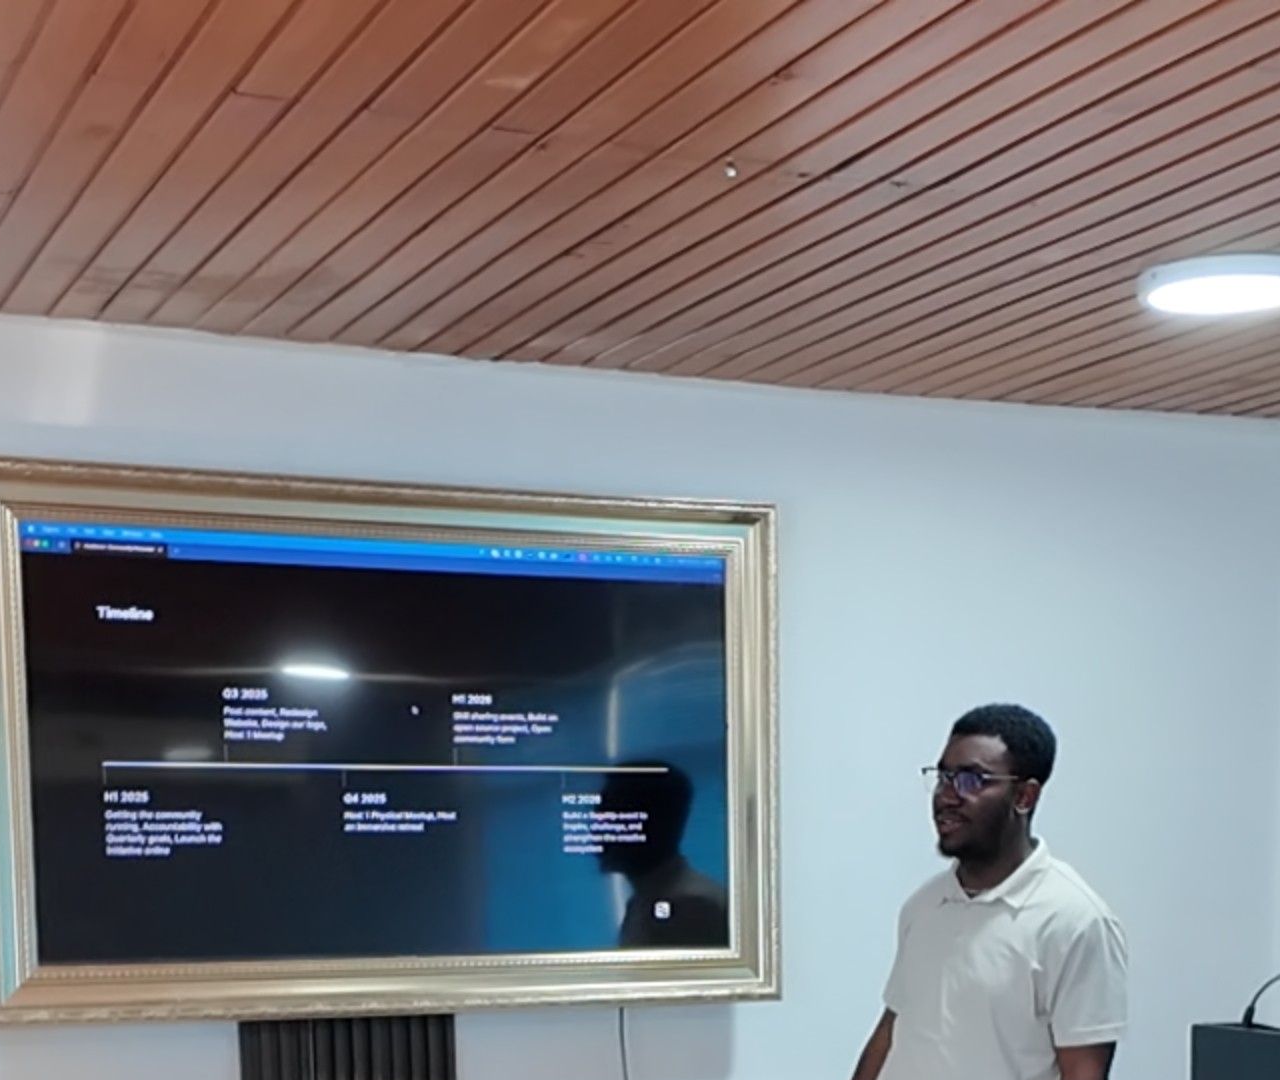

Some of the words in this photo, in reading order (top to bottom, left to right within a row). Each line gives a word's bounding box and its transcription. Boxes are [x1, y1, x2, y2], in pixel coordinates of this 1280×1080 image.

[96, 604, 154, 621] Timeline
[104, 790, 119, 803] H1
[120, 790, 150, 803] 2025
